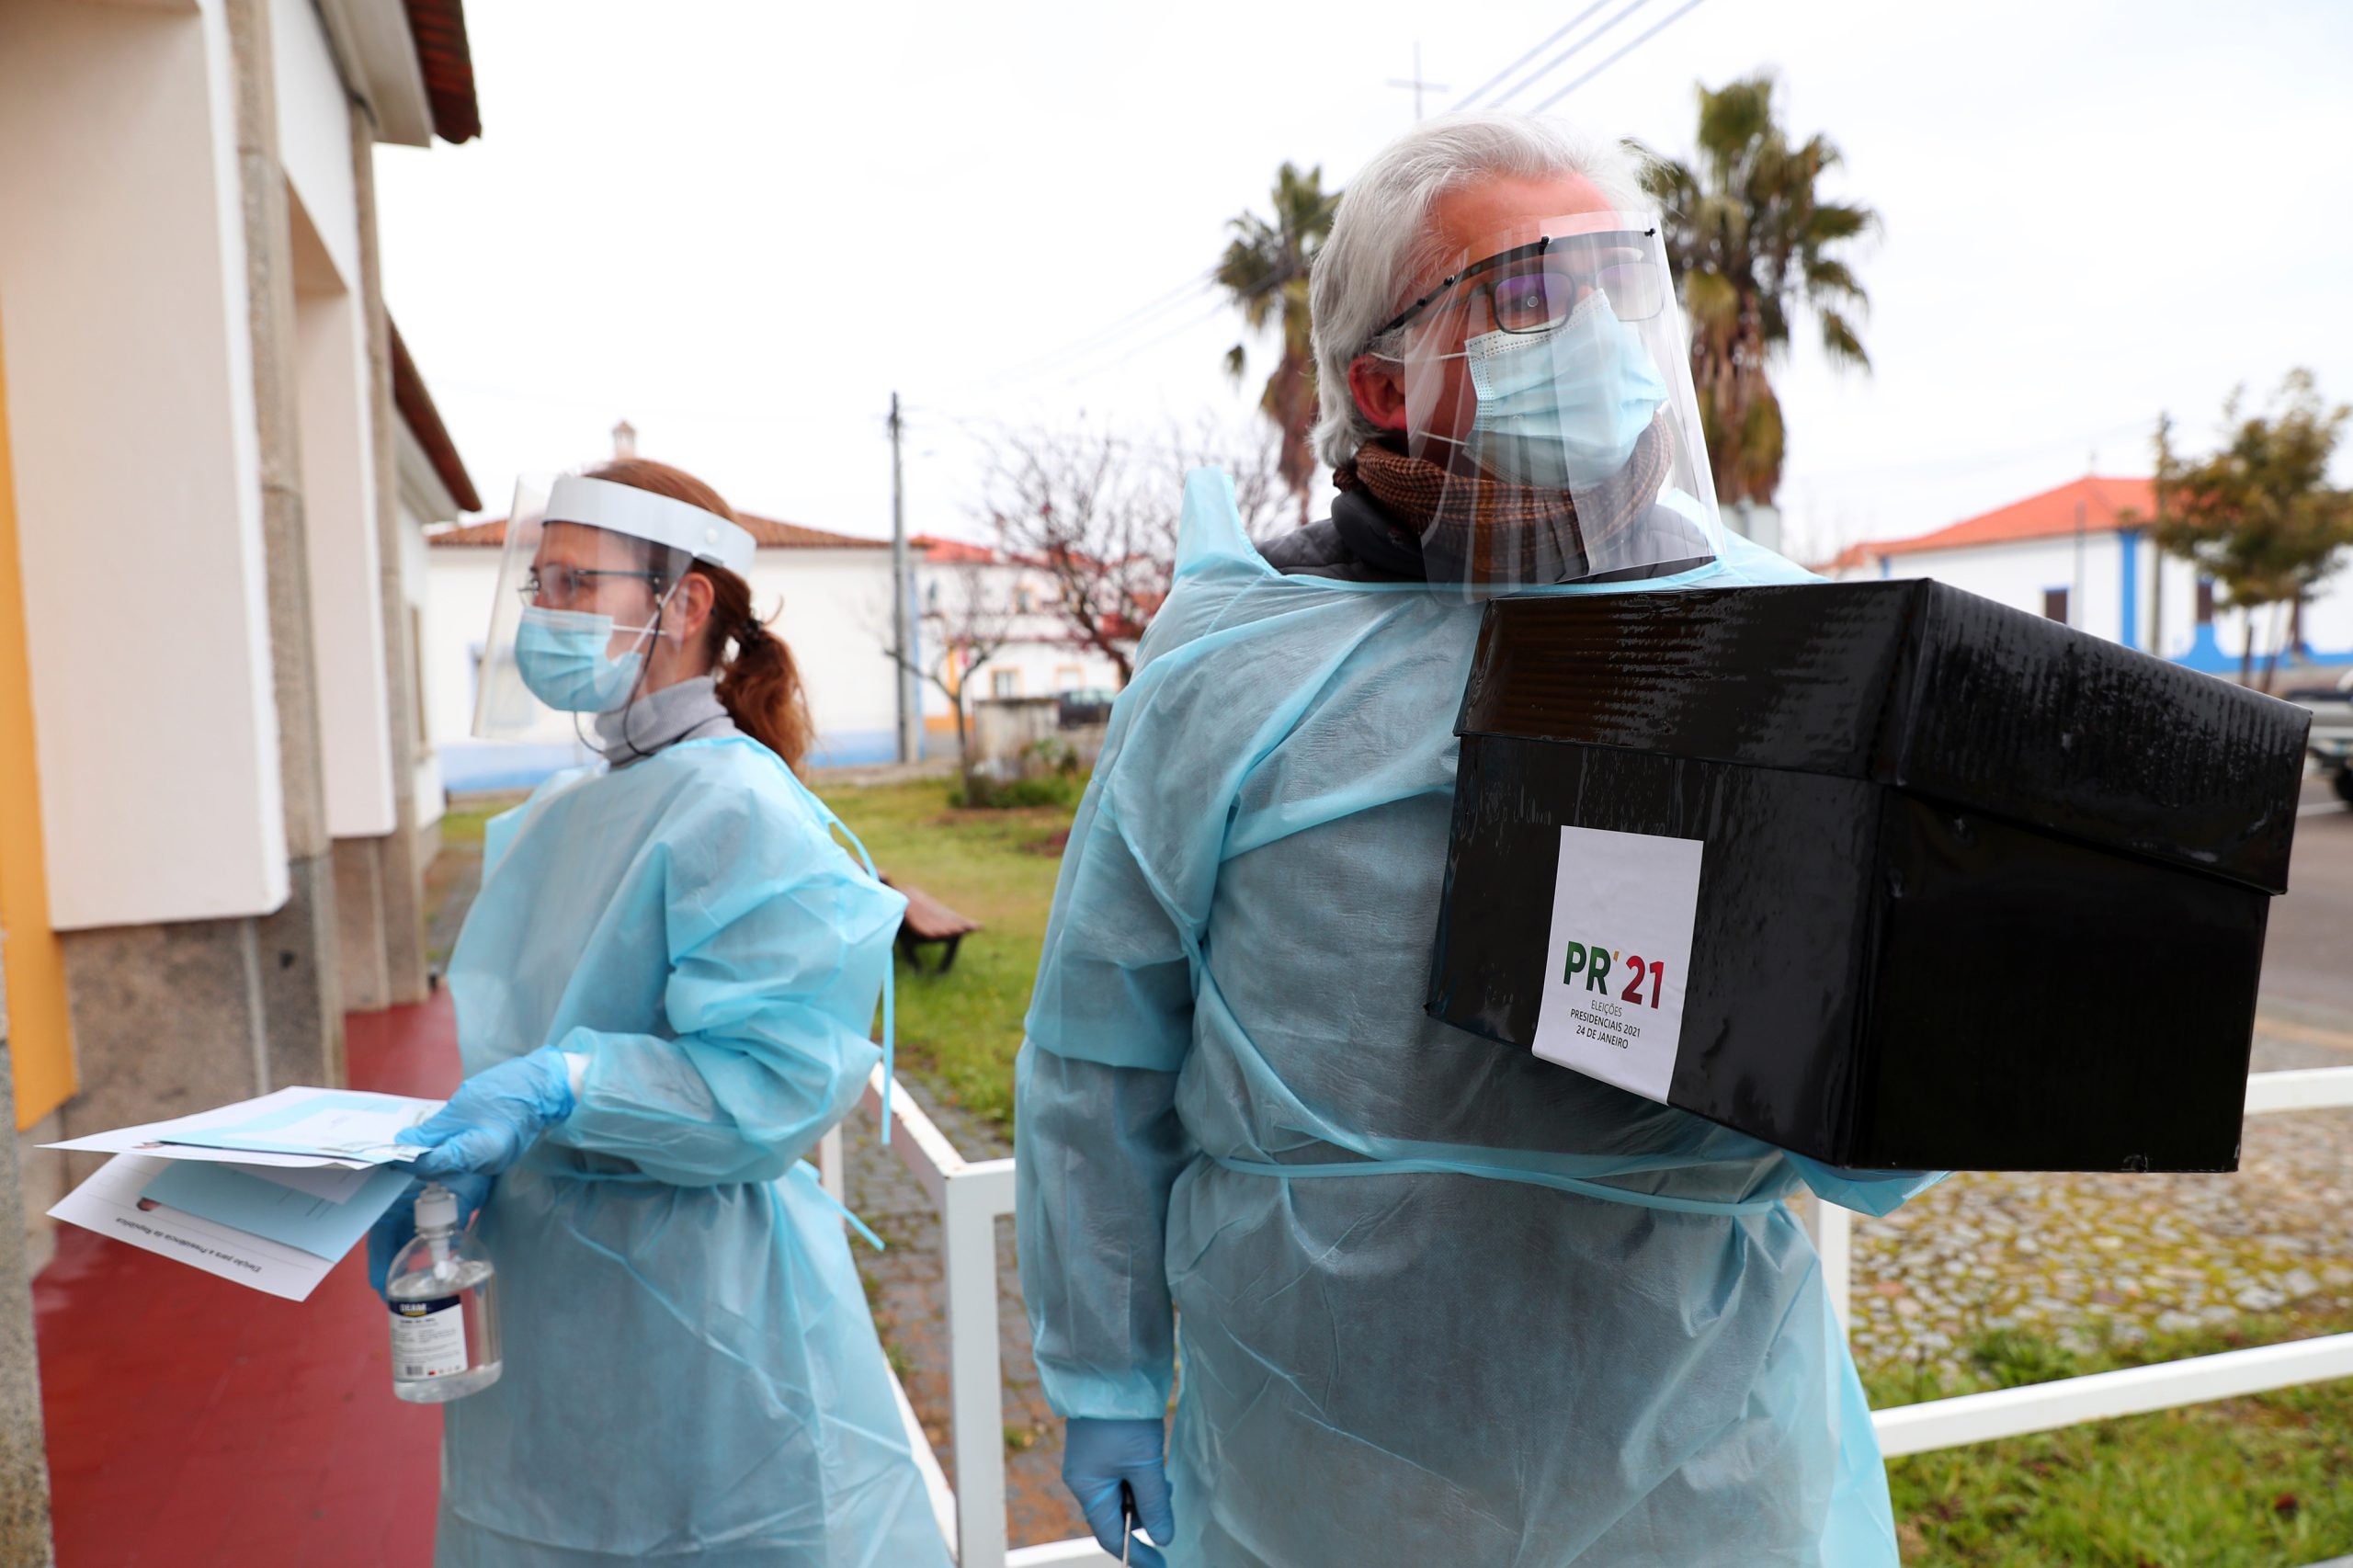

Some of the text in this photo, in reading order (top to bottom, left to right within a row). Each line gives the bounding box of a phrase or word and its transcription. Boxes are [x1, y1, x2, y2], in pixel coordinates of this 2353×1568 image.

[1591, 999, 1623, 1017] ELEIÇÕES
[1570, 1008, 1641, 1038] PRESIDENCIAIS 2021
[1576, 1025, 1629, 1050] 24 DE JANEIRO
